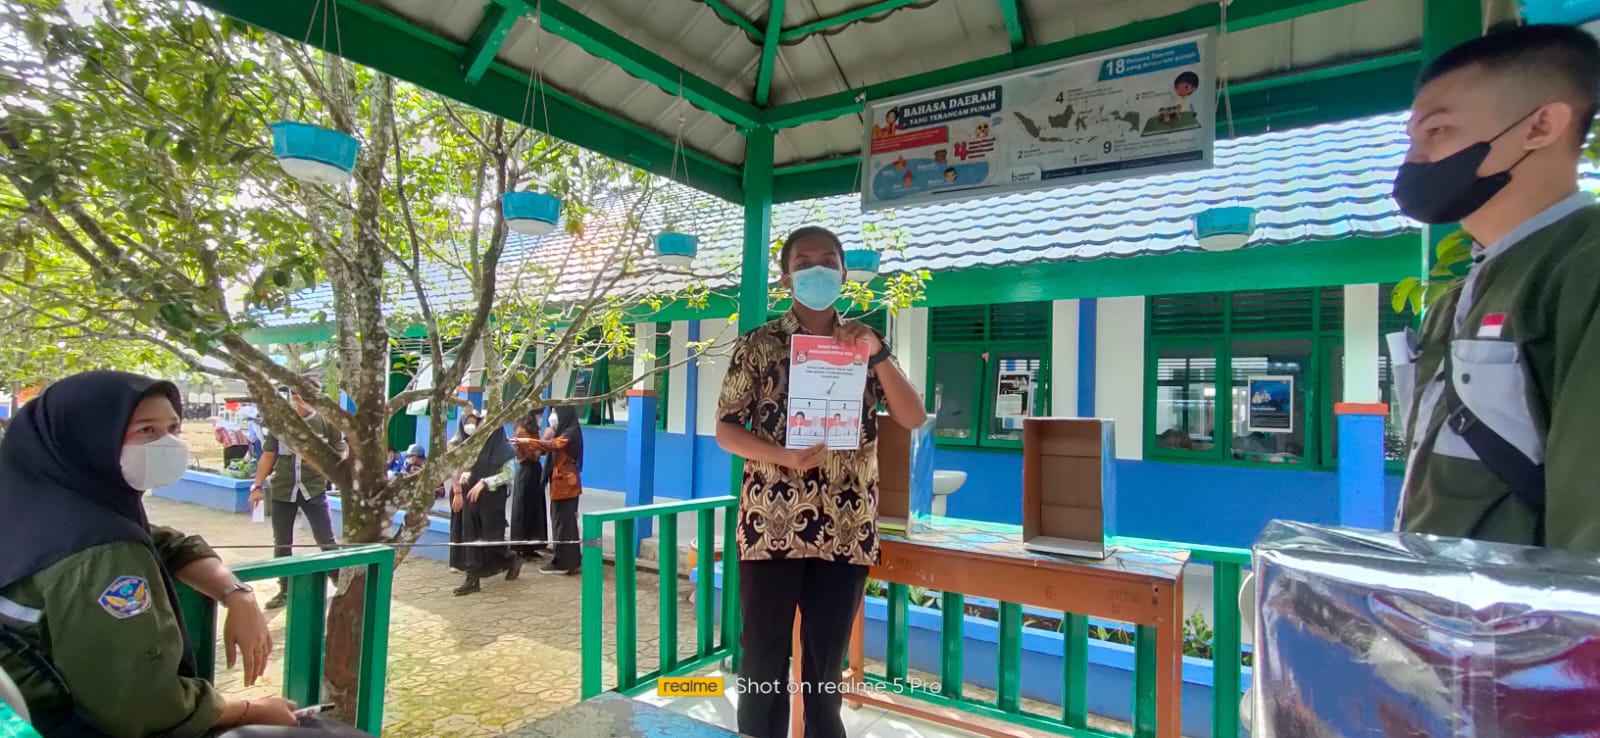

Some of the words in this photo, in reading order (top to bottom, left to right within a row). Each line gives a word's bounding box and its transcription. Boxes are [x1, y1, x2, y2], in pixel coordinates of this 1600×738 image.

[1106, 59, 1125, 76] 18
[904, 101, 946, 118] BAHASA
[948, 90, 996, 109] DAERAH
[1055, 91, 1064, 103] 4
[930, 108, 969, 121] TERANCAM
[970, 103, 996, 113] PUNAH
[1103, 141, 1112, 154] 9
